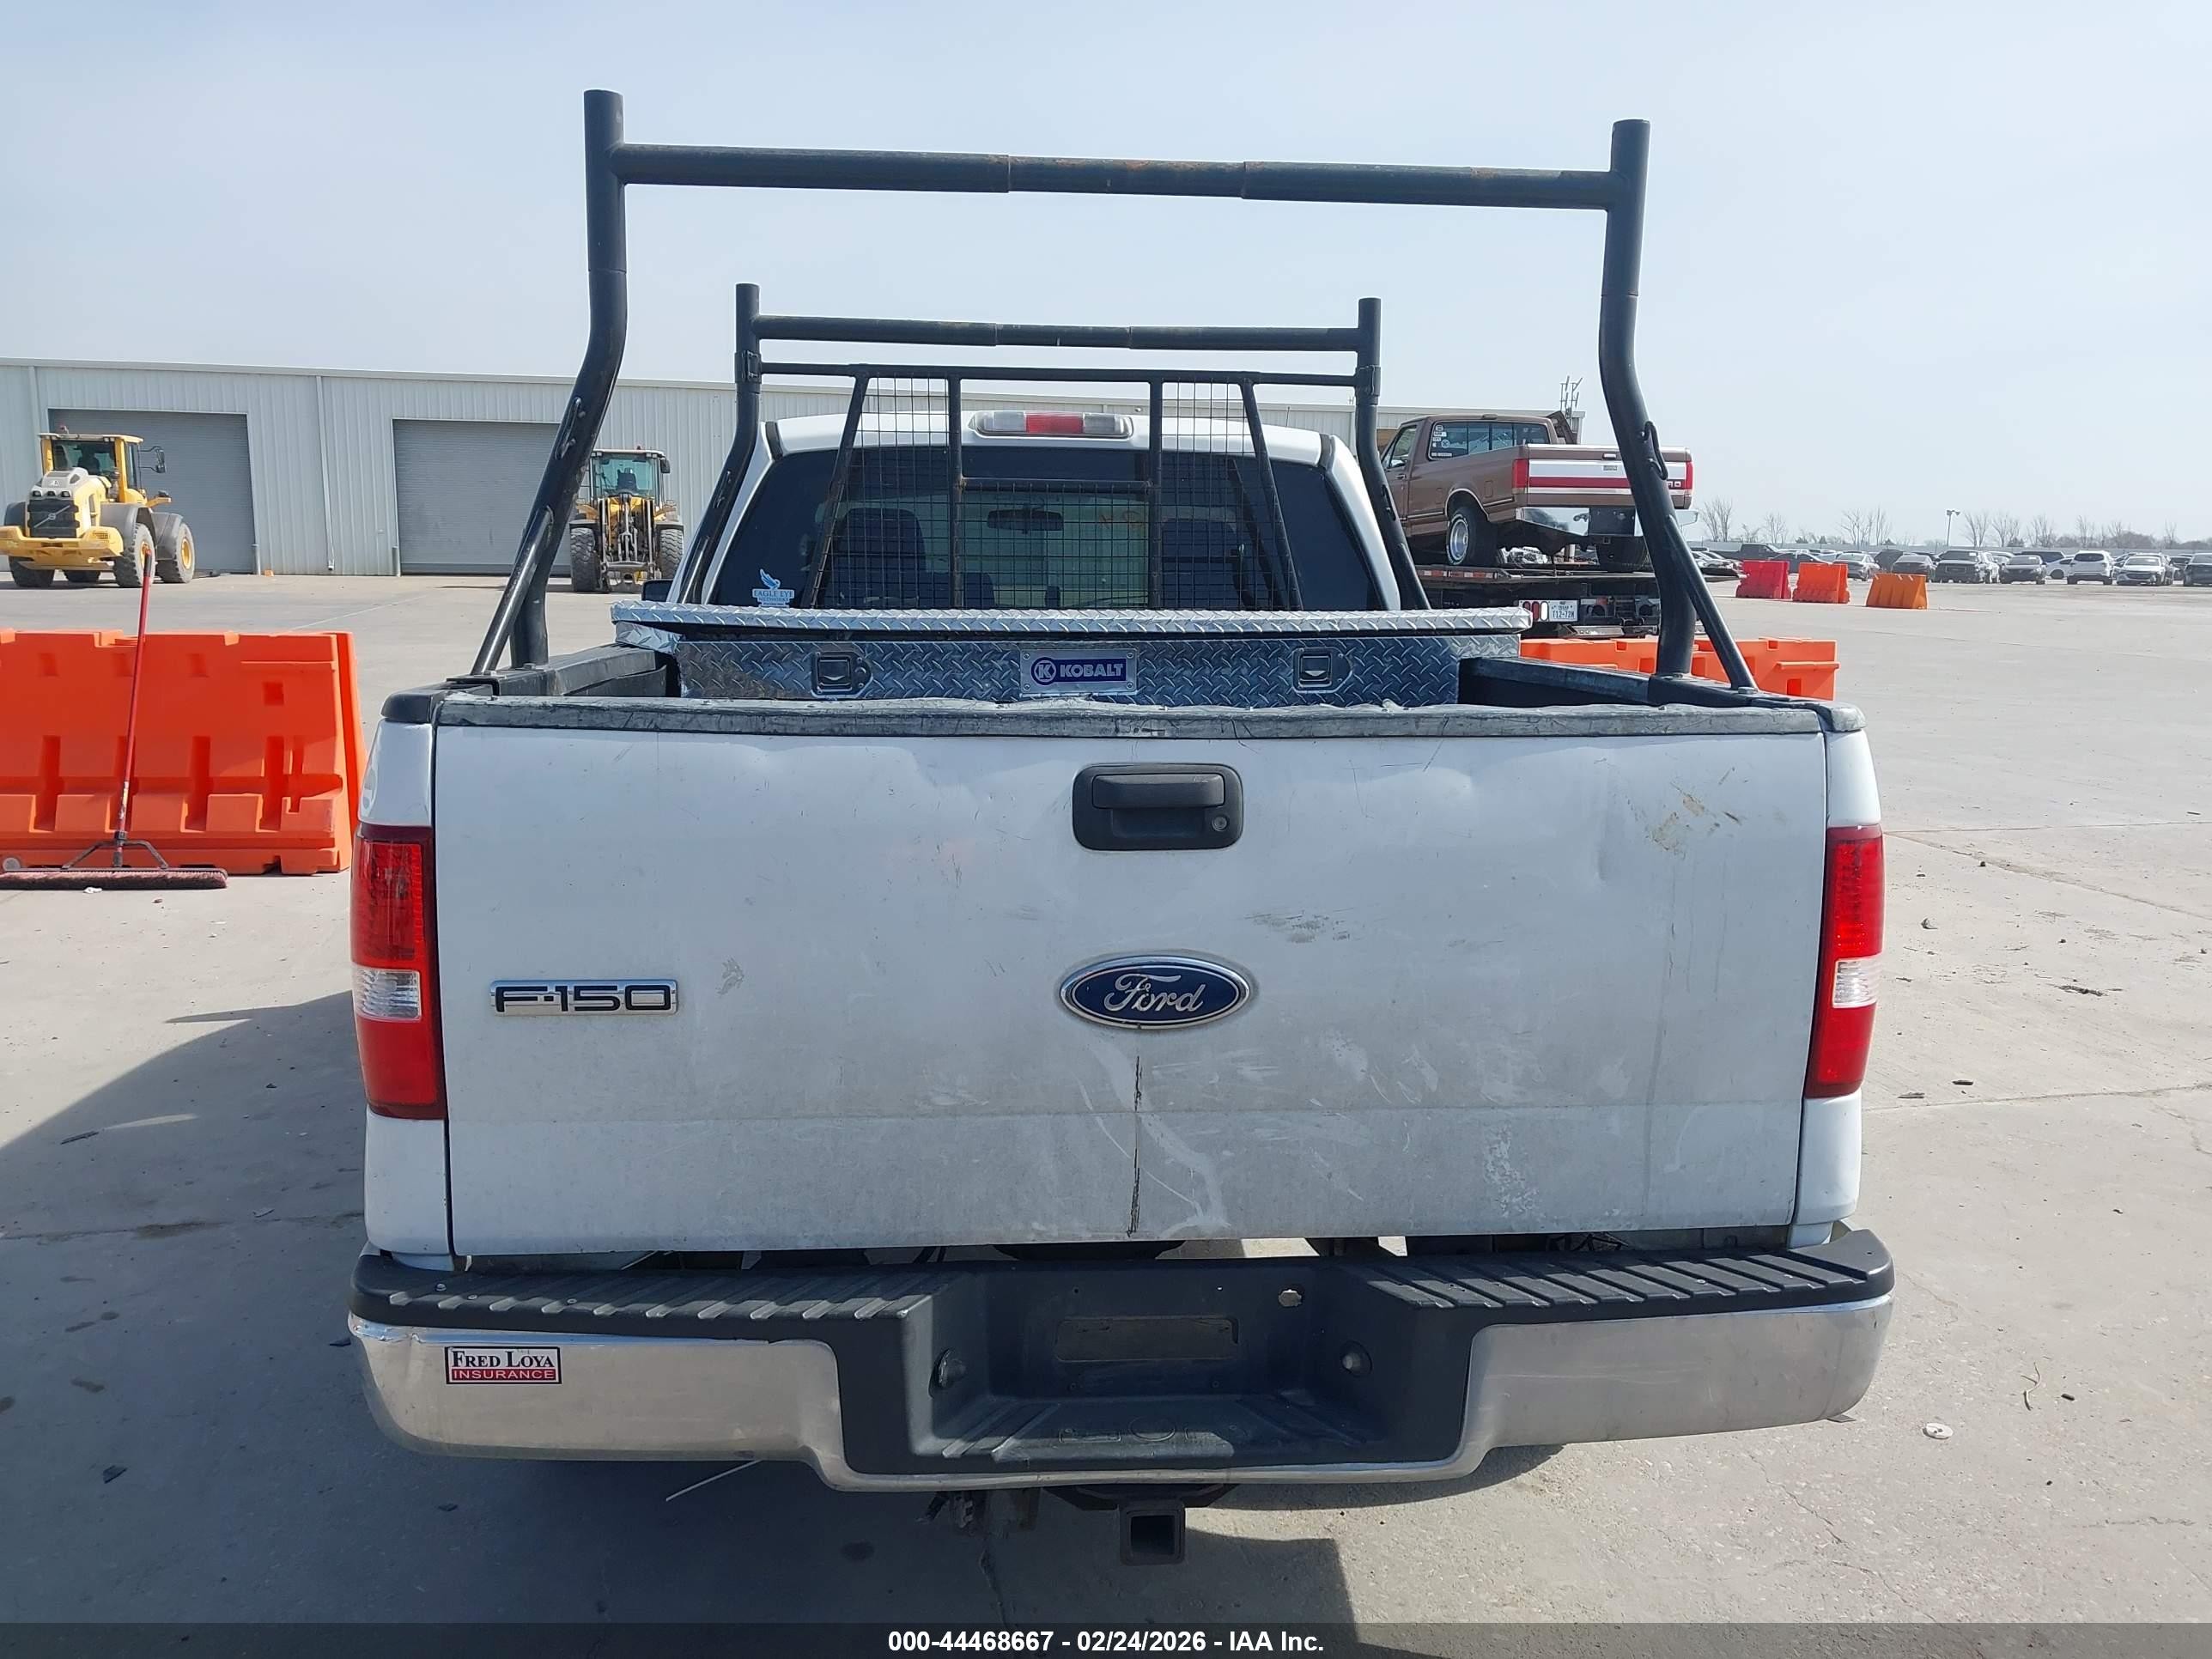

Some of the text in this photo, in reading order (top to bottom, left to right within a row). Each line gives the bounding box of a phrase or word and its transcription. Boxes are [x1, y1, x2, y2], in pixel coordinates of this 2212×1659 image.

[1060, 663, 1124, 678] KOBALT
[495, 984, 672, 1012] F-150
[1103, 973, 1206, 1012] Ford
[452, 1350, 555, 1367] FRED LOYA
[453, 1370, 555, 1379] INSURANCE
